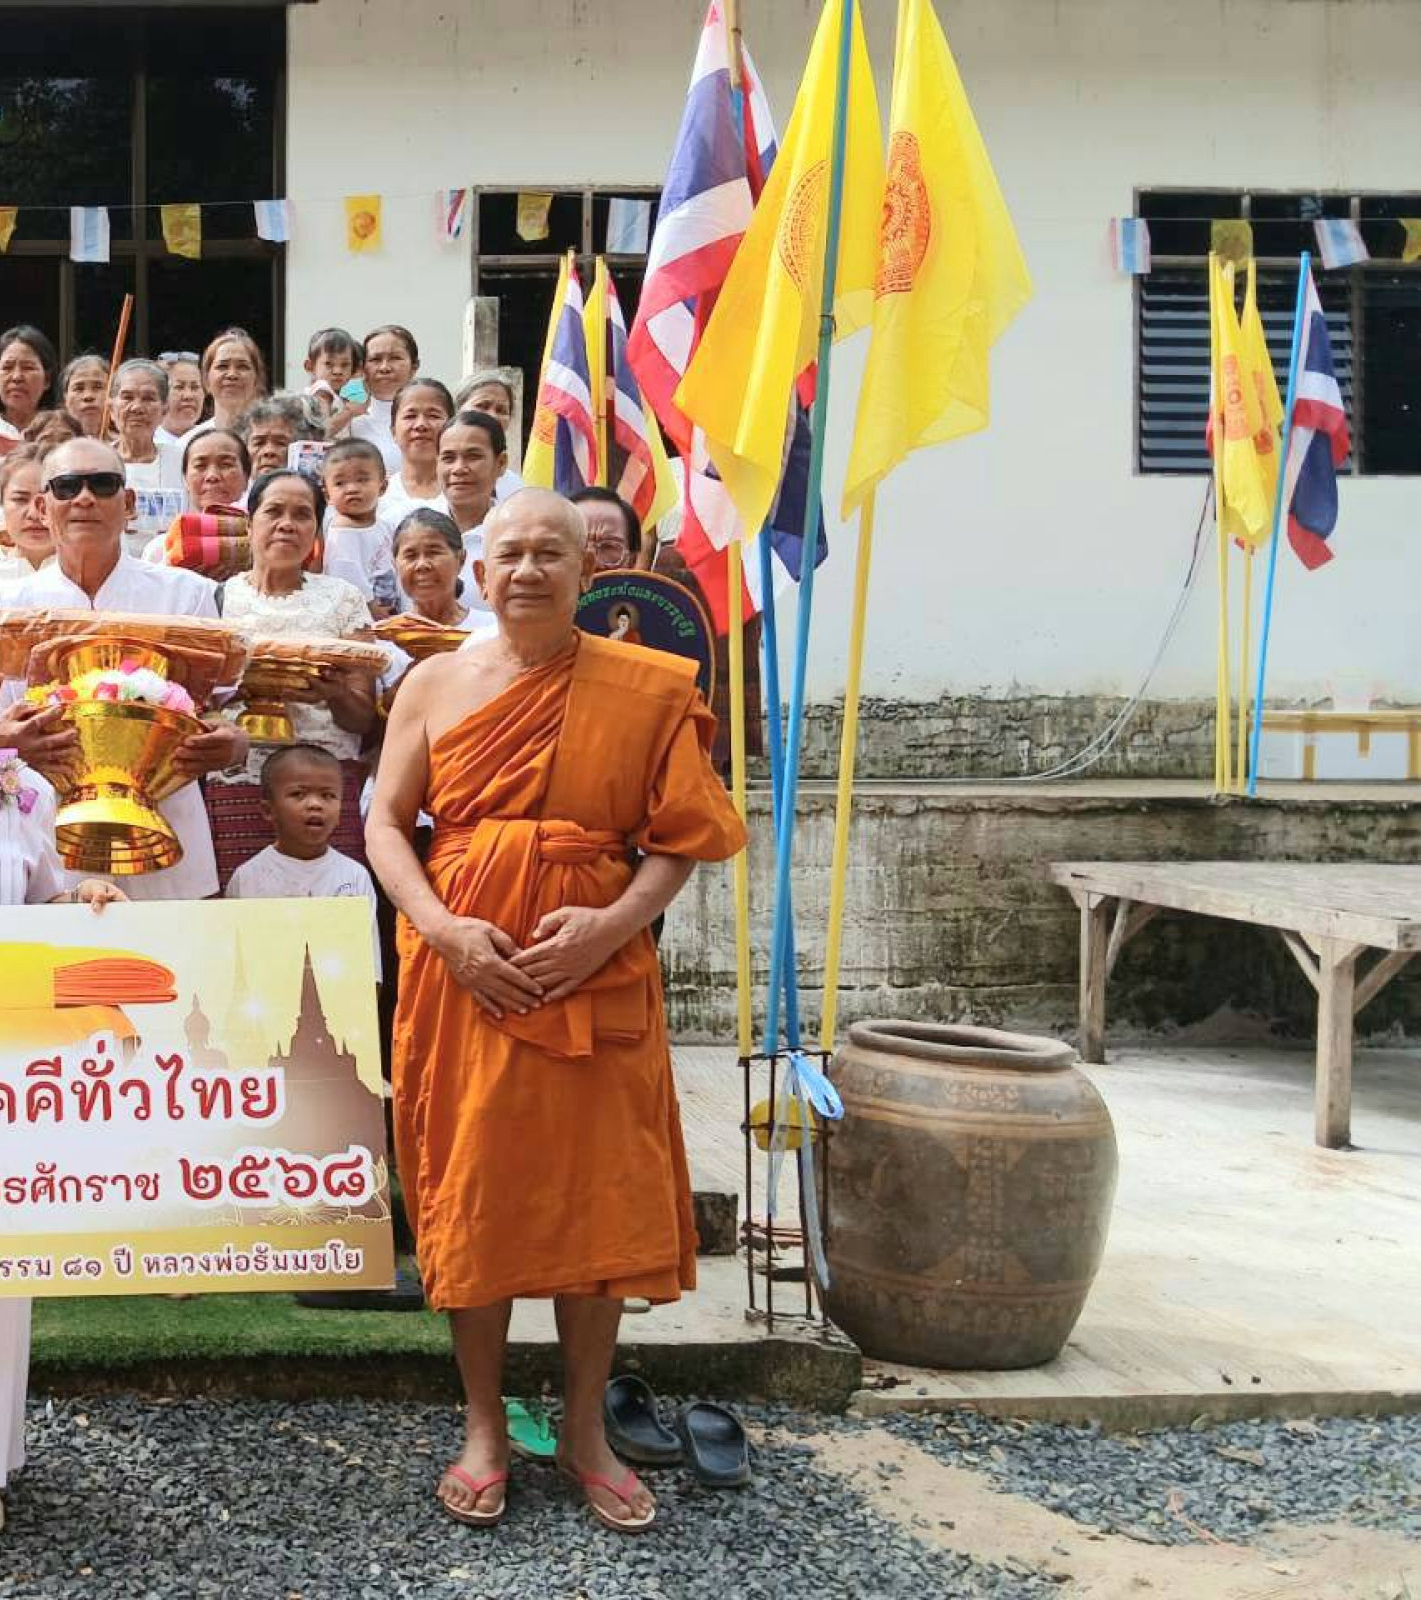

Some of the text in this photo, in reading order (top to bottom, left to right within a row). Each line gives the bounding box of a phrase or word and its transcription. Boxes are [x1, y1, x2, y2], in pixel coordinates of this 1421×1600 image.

[178, 1154, 366, 1200] ๒๕๖๘
[63, 1257, 102, 1276] ๘๑
[114, 1247, 132, 1275] ปี
[144, 1243, 361, 1274] หลวงพ่อธัมมชโย
